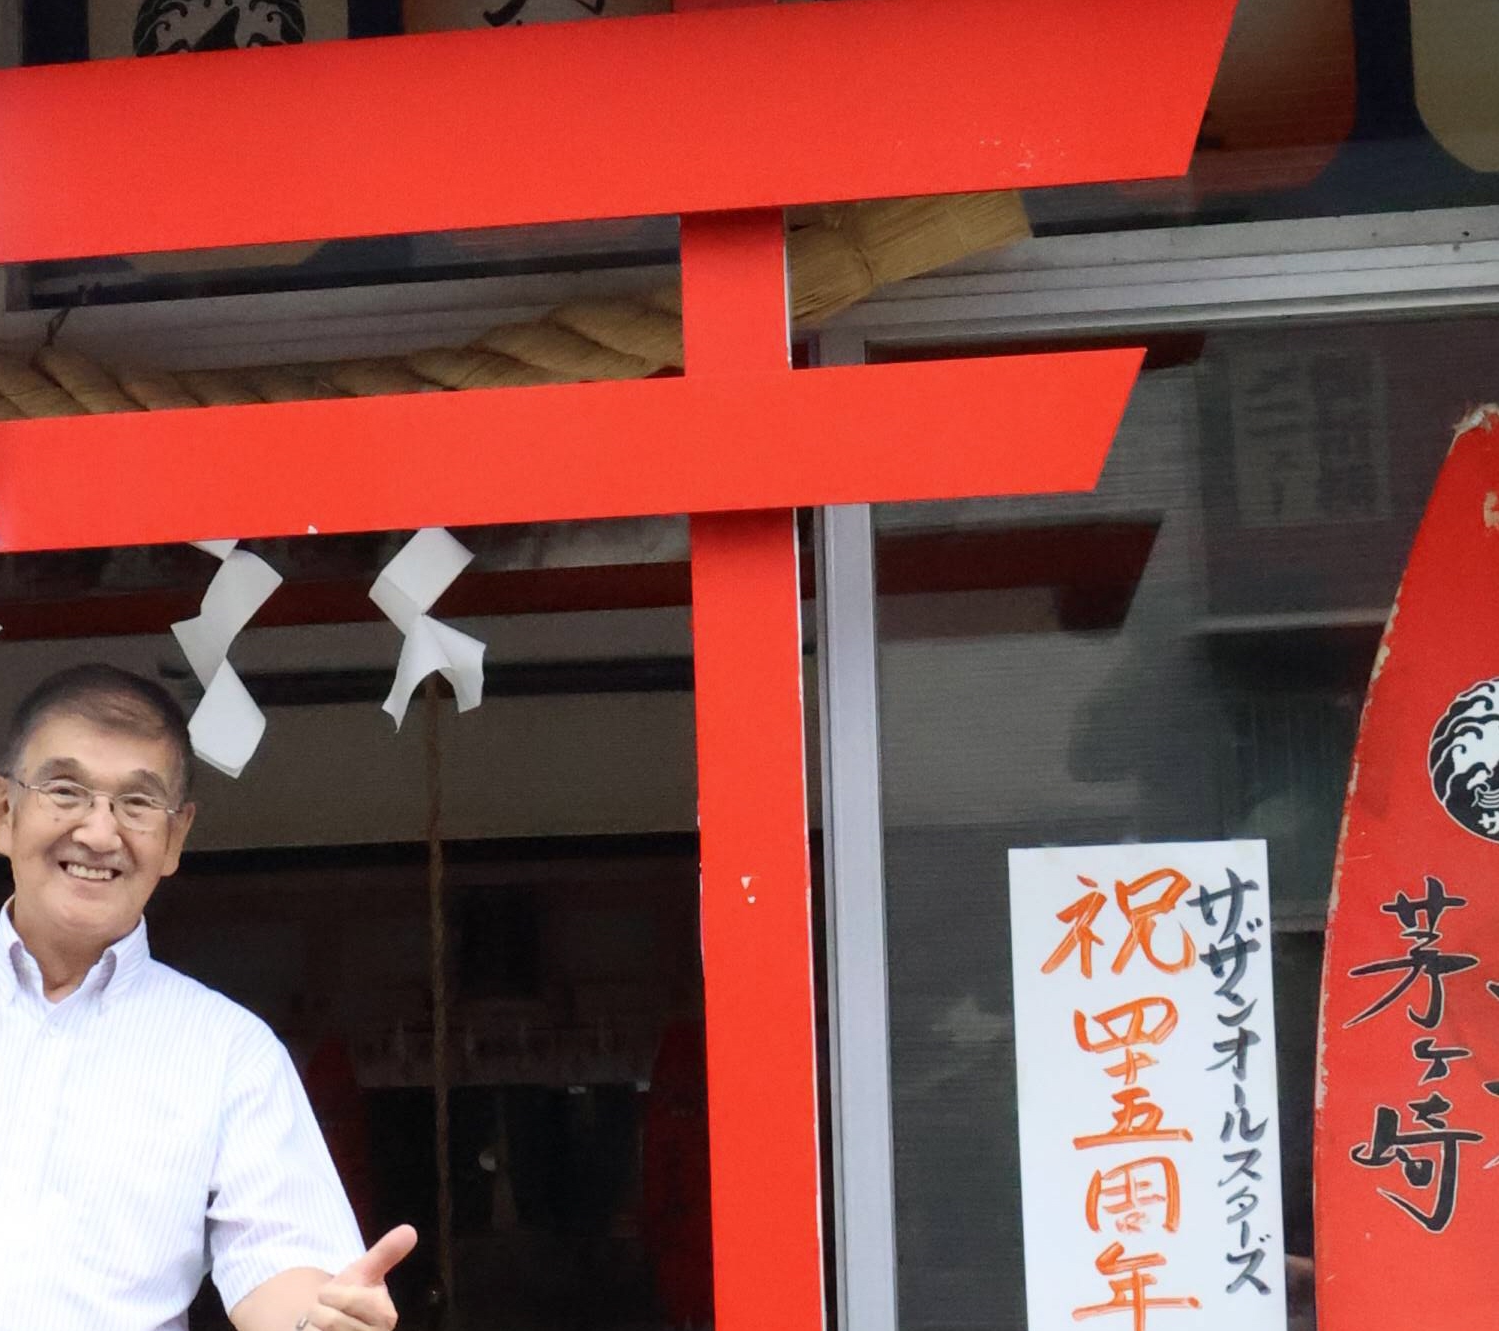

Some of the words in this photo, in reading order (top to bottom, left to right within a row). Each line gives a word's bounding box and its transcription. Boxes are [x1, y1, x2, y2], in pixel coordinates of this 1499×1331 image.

[1187, 868, 1272, 1297] サザンオールスターズ
[1343, 876, 1484, 1233] 茅ヶ崎
